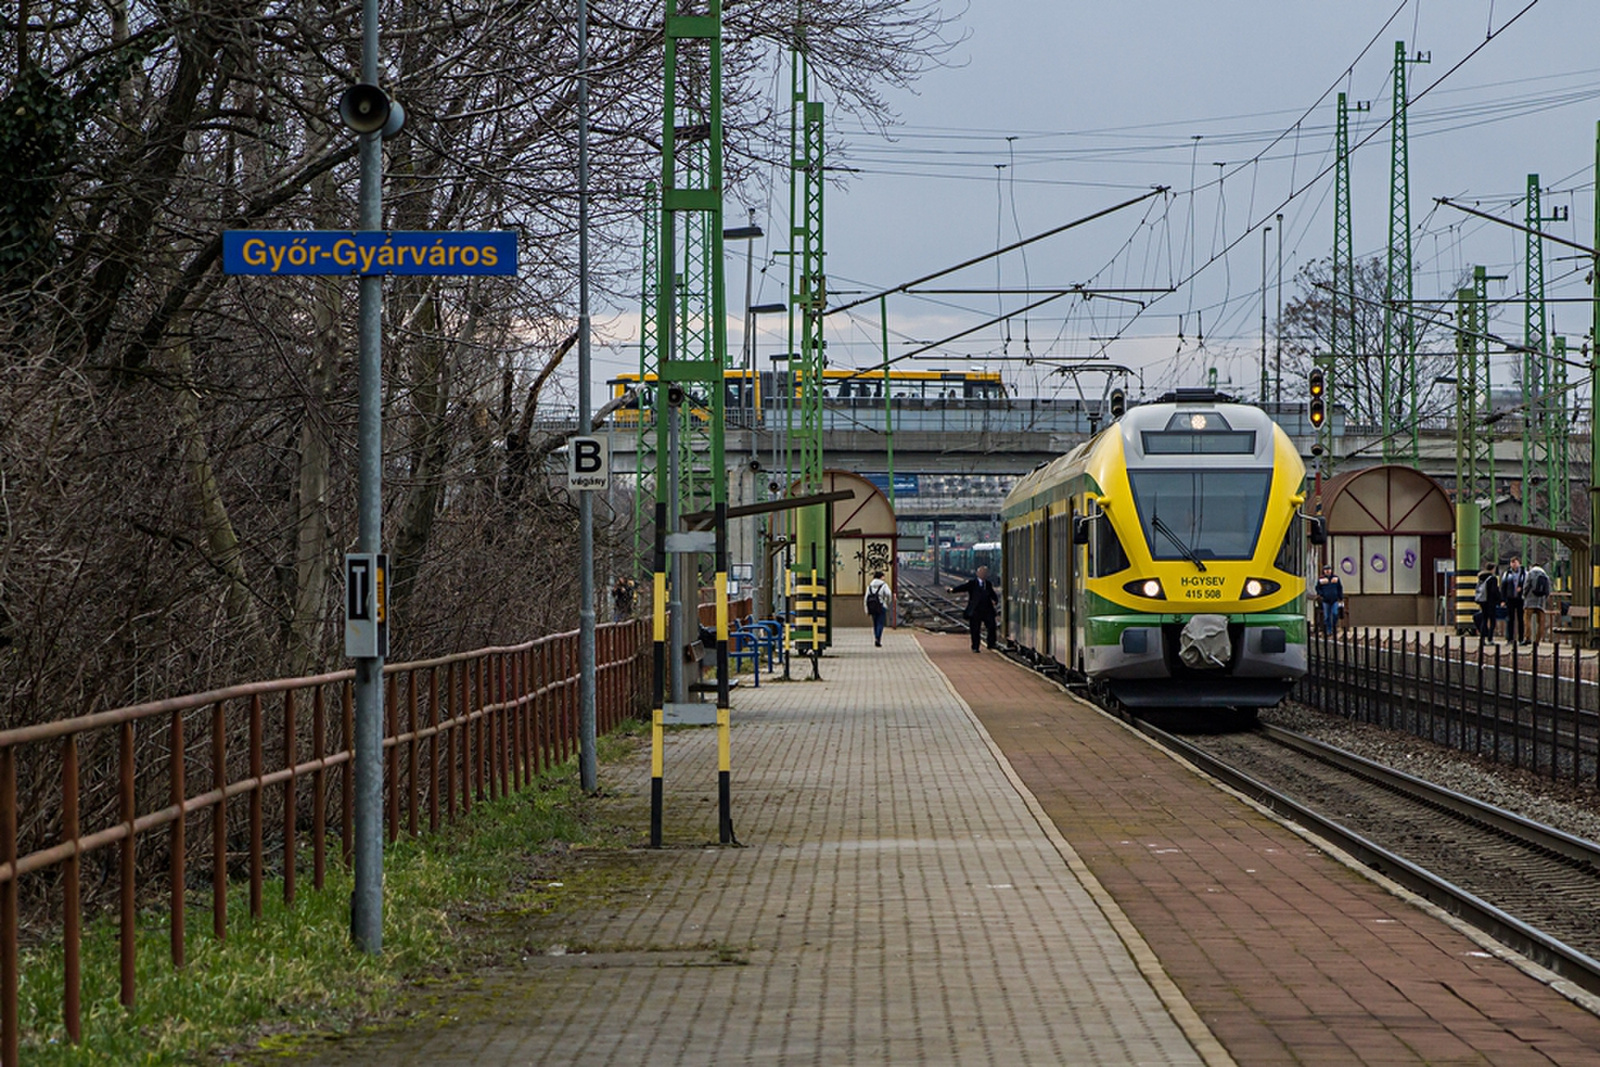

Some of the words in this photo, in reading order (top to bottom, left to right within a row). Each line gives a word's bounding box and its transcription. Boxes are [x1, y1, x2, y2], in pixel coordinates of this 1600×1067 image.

[242, 238, 499, 272] Győr-Gyárváros
[575, 440, 602, 473] B
[571, 476, 606, 487] vágány
[1181, 576, 1226, 586] H-GYSEV
[1185, 589, 1203, 599] 415
